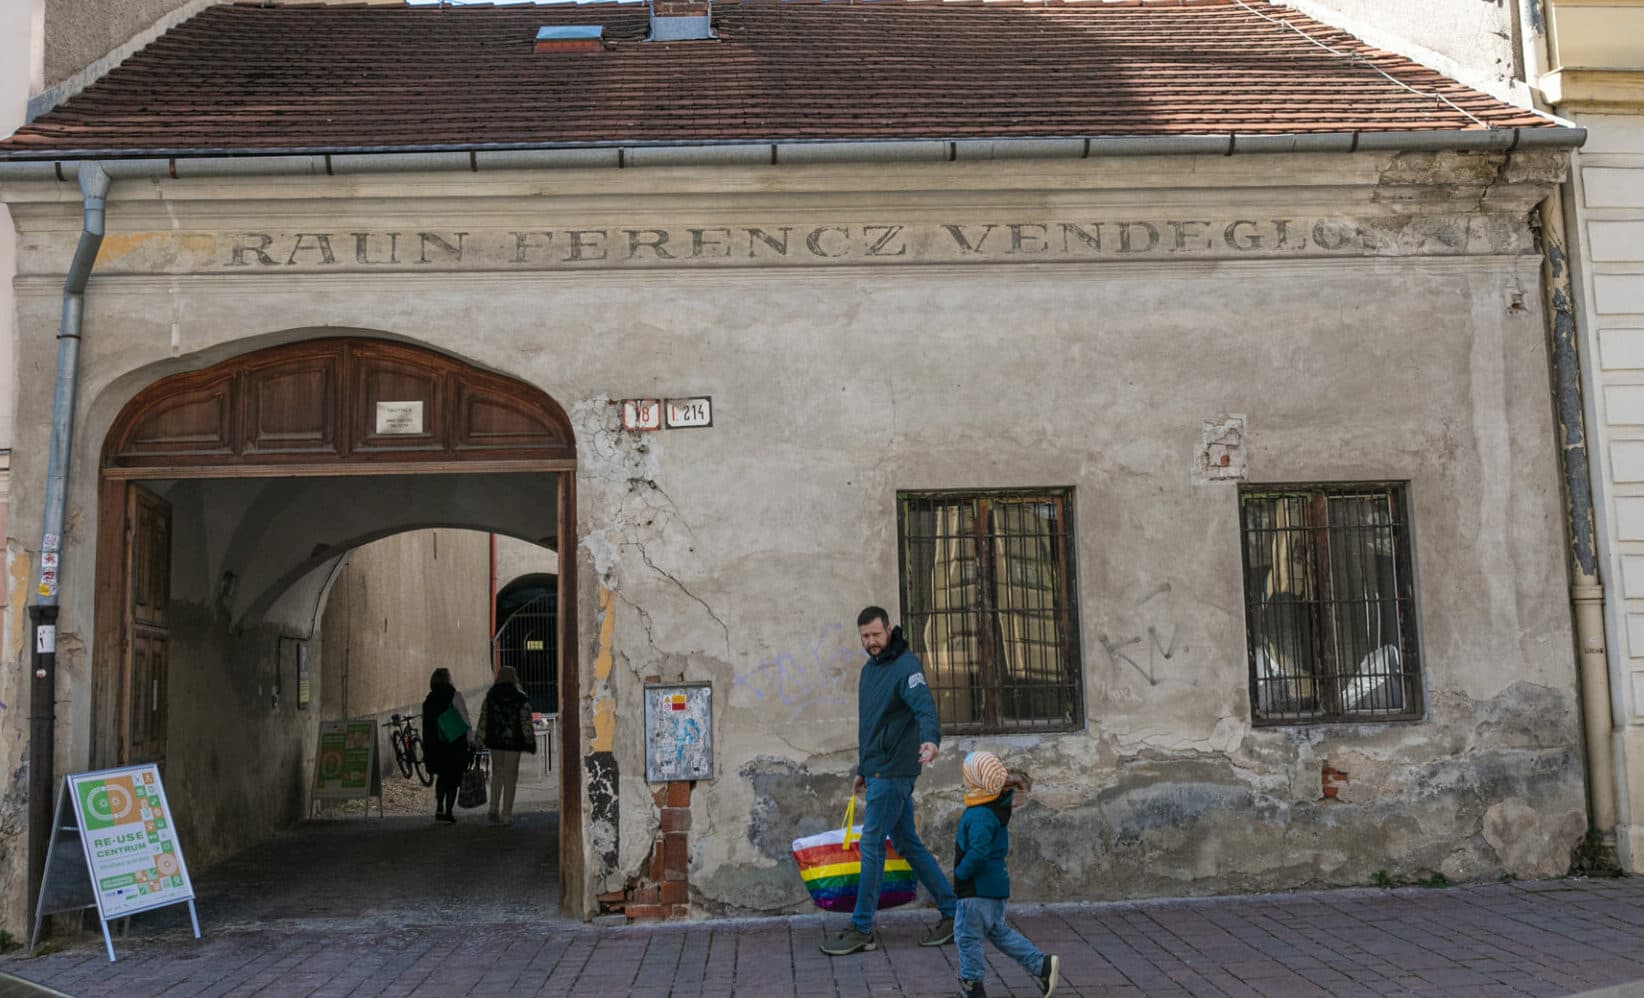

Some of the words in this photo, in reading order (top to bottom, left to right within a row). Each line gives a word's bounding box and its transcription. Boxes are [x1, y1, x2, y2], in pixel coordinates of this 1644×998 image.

[509, 225, 906, 263] FERENCZ
[941, 218, 1377, 256] VENDEGLO
[684, 404, 705, 421] 214
[95, 832, 144, 847] RE-USE
[97, 843, 146, 857] CENTRUM
